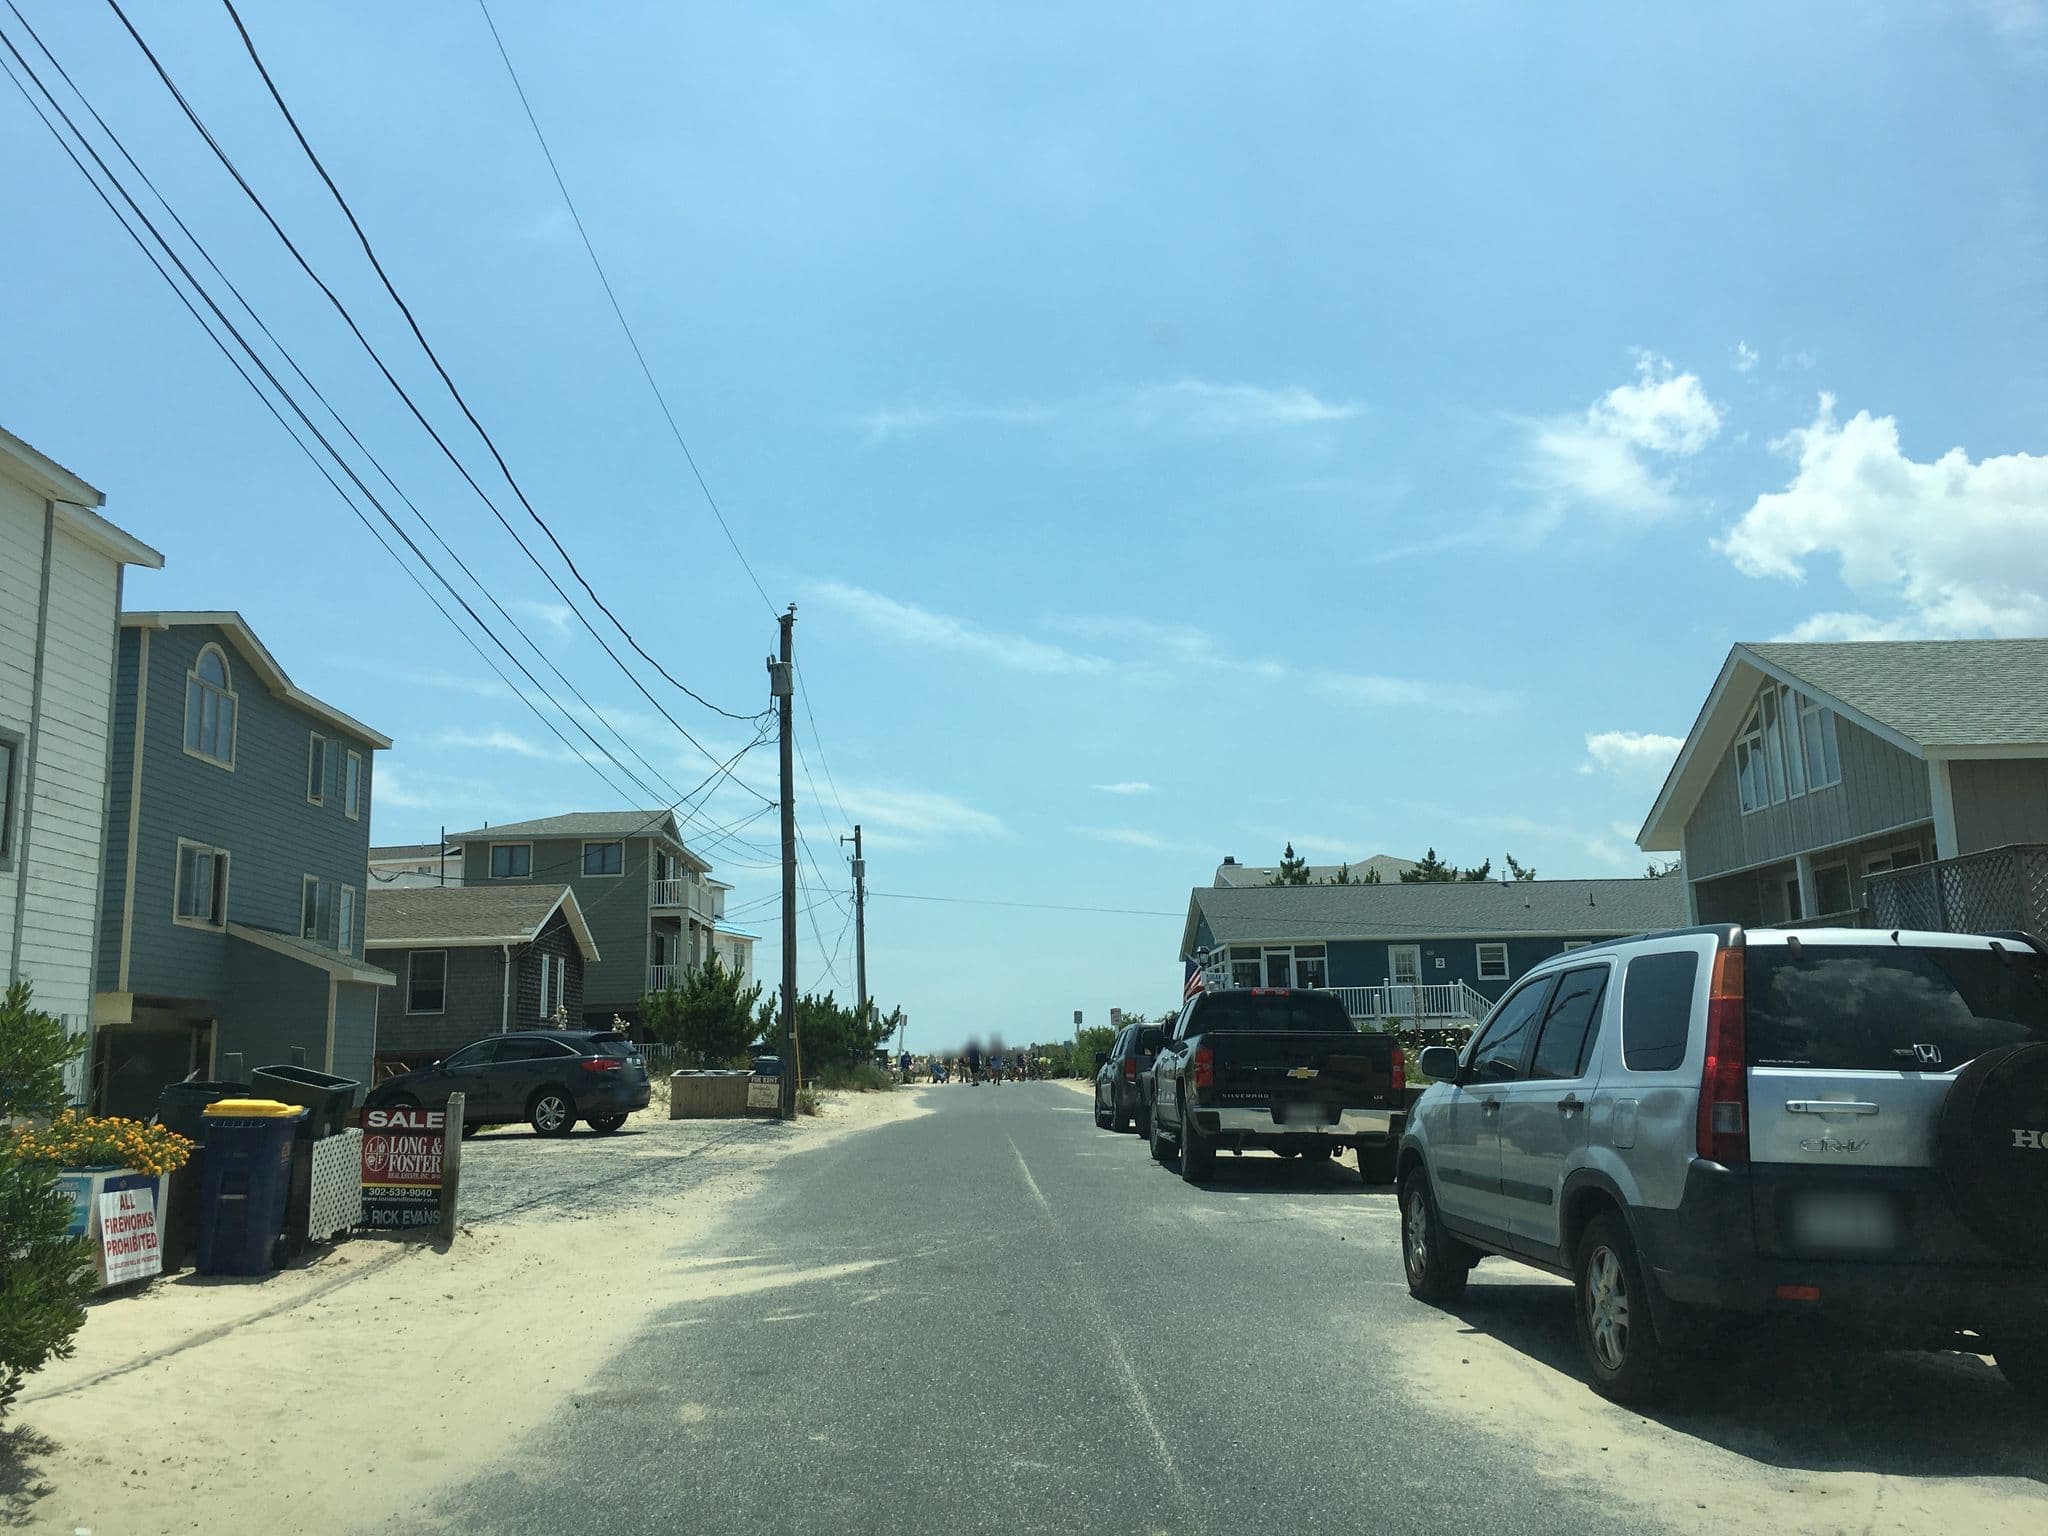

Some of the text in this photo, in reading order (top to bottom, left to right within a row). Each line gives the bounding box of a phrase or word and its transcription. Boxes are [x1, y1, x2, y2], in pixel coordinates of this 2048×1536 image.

[368, 1110, 445, 1128] SALE
[390, 1136, 443, 1155] LONG &
[389, 1154, 441, 1173] FOSTER
[368, 1187, 432, 1197] 302-539-9040
[119, 1193, 135, 1210] ALL
[104, 1211, 154, 1235] FIREWORKS
[372, 1209, 440, 1225] RICK EVANS
[106, 1232, 157, 1257] PROHIBITED
